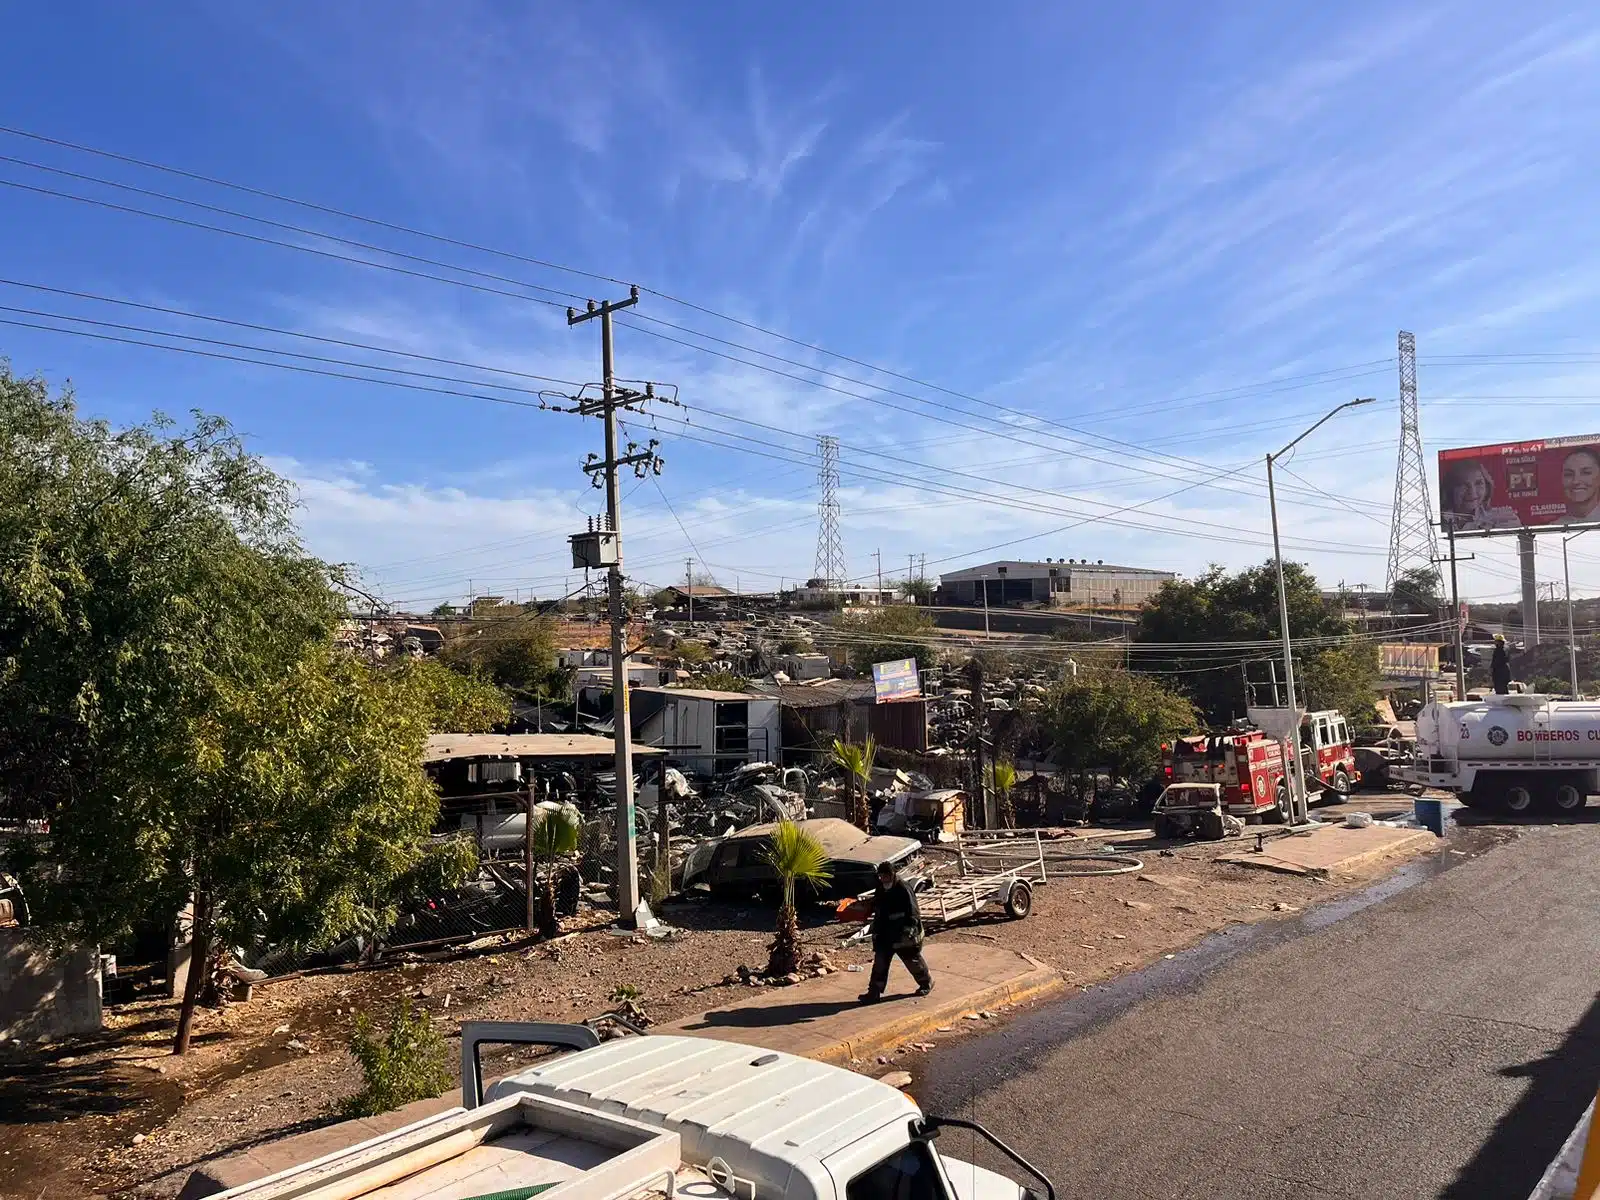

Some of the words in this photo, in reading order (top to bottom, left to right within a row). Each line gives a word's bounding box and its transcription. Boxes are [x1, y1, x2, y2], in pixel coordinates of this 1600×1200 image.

[1510, 473, 1534, 489] PT
[1530, 503, 1566, 511] CLAUDIA
[1460, 728, 1470, 739] 23
[1517, 730, 1580, 741] BOMBEROS
